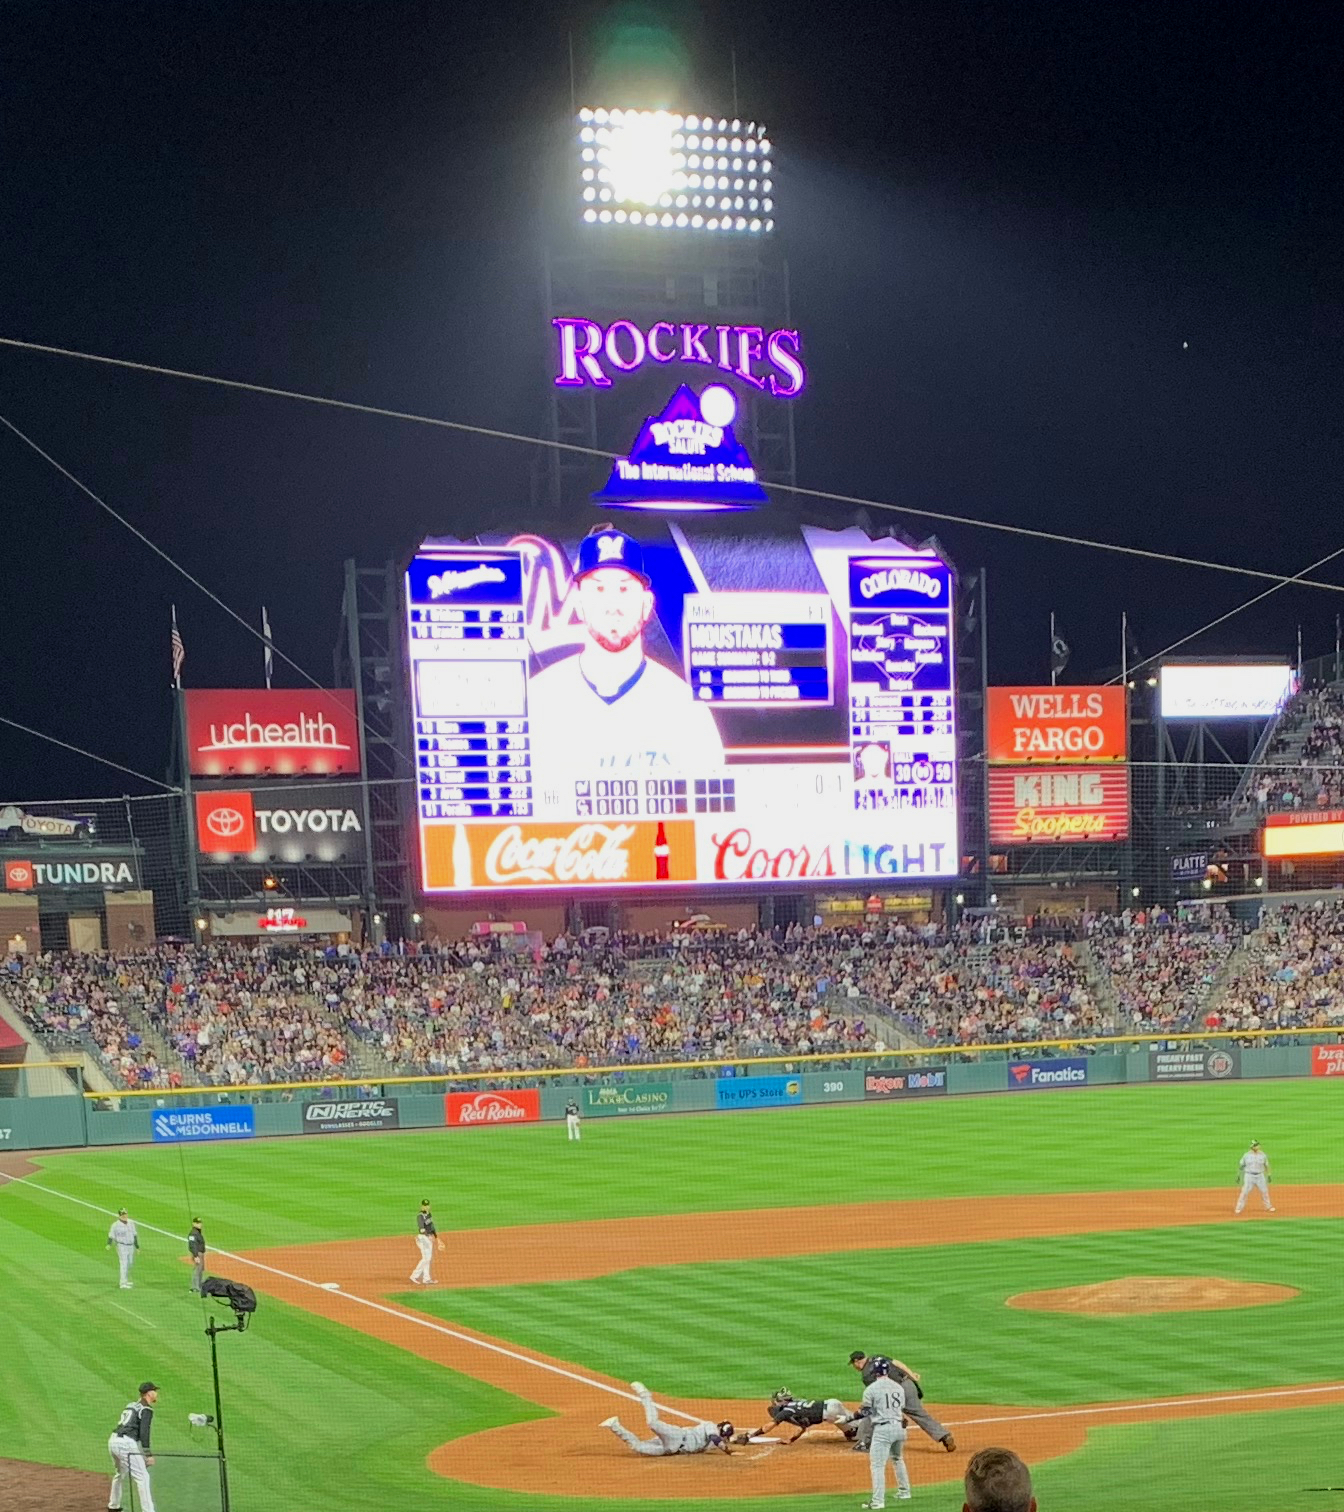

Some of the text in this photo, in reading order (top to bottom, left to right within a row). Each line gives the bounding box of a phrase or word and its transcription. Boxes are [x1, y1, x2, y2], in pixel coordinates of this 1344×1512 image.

[552, 317, 805, 396] ROCKIES
[616, 460, 640, 481] The
[860, 569, 941, 598] COLORADO
[690, 624, 783, 649] MOUSTAKAS
[1010, 693, 1103, 718] WELLS
[210, 712, 337, 747] uchealth
[1013, 727, 1104, 751] FARGO
[1014, 774, 1104, 807] KING
[256, 810, 362, 833] TOYOTA
[1013, 805, 1107, 837] Soopers
[1289, 813, 1329, 824] POWERED
[1331, 812, 1343, 822] BY
[485, 824, 635, 882] Coca-Cola
[713, 828, 836, 880] Coors
[1173, 855, 1206, 870] PLATTE
[32, 862, 134, 884] TUNDRA
[1157, 1052, 1204, 1064] FREAKY FAST
[1031, 1066, 1085, 1084] Fanatics
[1157, 1063, 1185, 1073] FREAKY
[908, 1072, 945, 1088] Mobil
[624, 1087, 668, 1105] CASINO
[719, 1087, 784, 1100] The UPS Store
[333, 1107, 396, 1120] NERVE
[334, 1101, 387, 1112] OPTIC
[459, 1104, 525, 1123] Red Robin
[170, 1113, 213, 1126] BURNS
[176, 1121, 252, 1137] McDONNELL
[885, 1391, 902, 1409] 18
